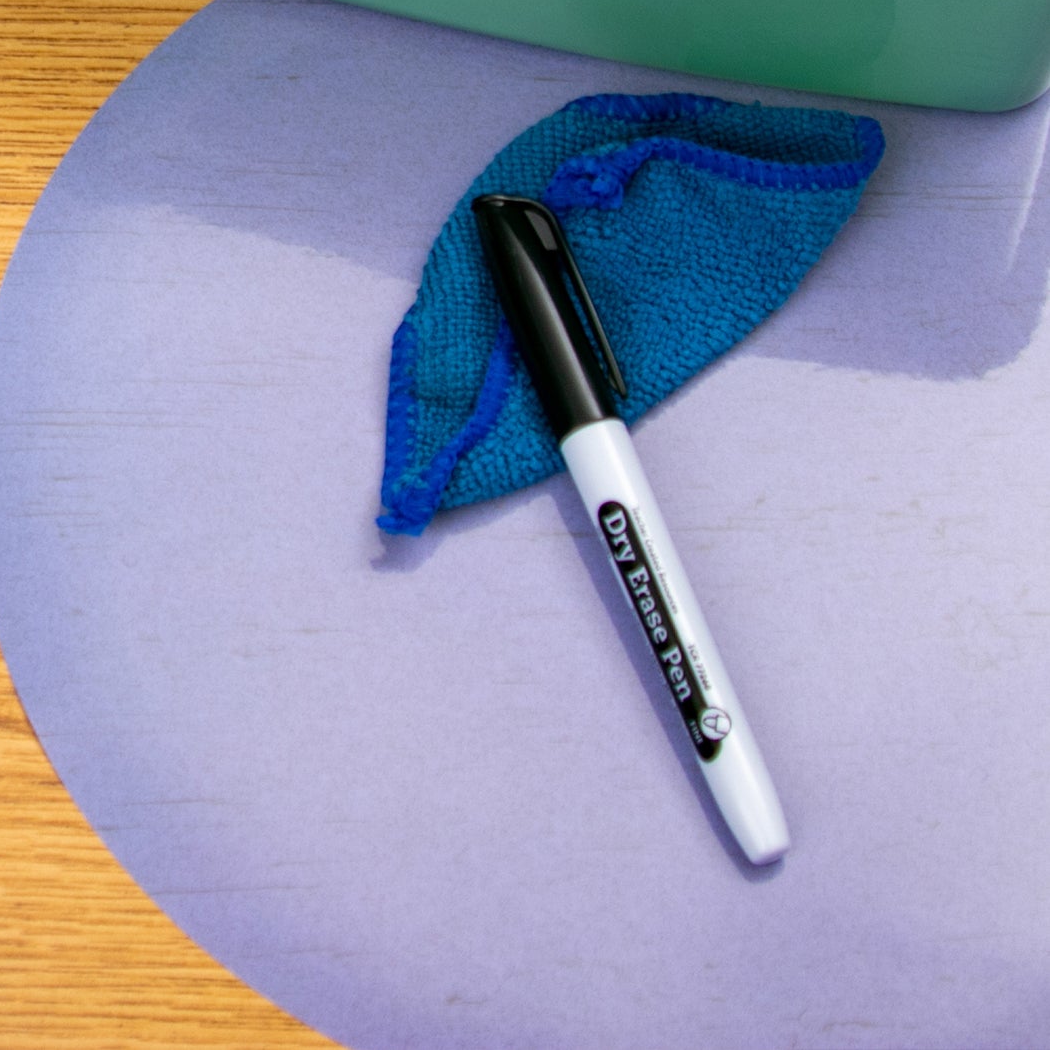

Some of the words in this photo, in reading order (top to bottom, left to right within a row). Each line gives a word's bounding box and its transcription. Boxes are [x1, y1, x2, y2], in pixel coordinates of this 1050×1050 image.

[602, 510, 636, 563] Dry
[628, 565, 668, 645] Erase
[661, 644, 693, 703] Pen
